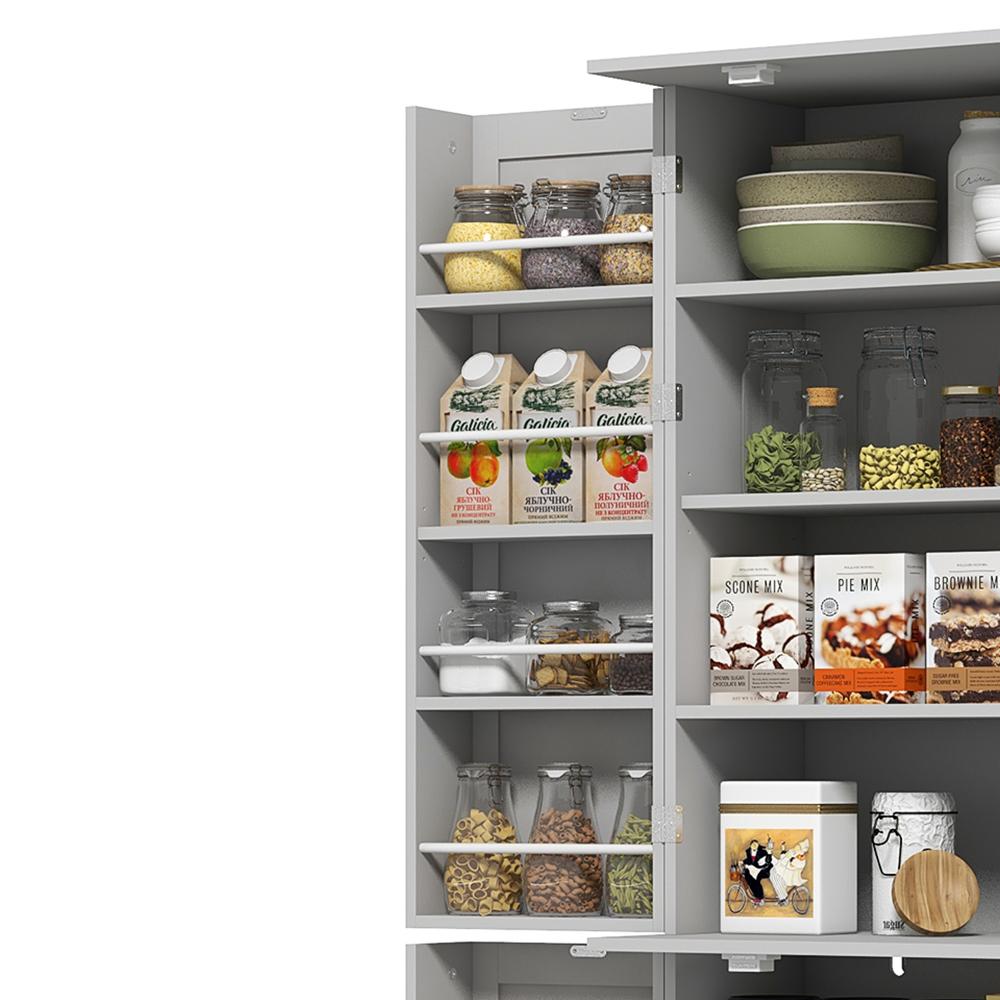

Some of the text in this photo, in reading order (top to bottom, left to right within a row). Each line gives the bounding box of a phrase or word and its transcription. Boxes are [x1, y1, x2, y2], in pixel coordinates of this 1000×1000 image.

[450, 417, 498, 432] Galicia
[596, 412, 648, 427] Galicia
[466, 487, 481, 496] СІК
[540, 486, 557, 496] СІК
[613, 482, 630, 492] СІК
[525, 496, 572, 505] ЯБЛУЧНО-
[598, 492, 646, 502] ЯБЛУЧНО-
[523, 504, 574, 513] ЧОРНИЧНИЙ
[594, 500, 650, 510] ПОЛУНИЧНИЙ
[725, 580, 784, 594] SCONE MIX
[838, 578, 881, 592] PIE MIX
[934, 576, 985, 591] BROWNIE
[805, 591, 814, 612] MIX
[911, 598, 920, 619] MIX
